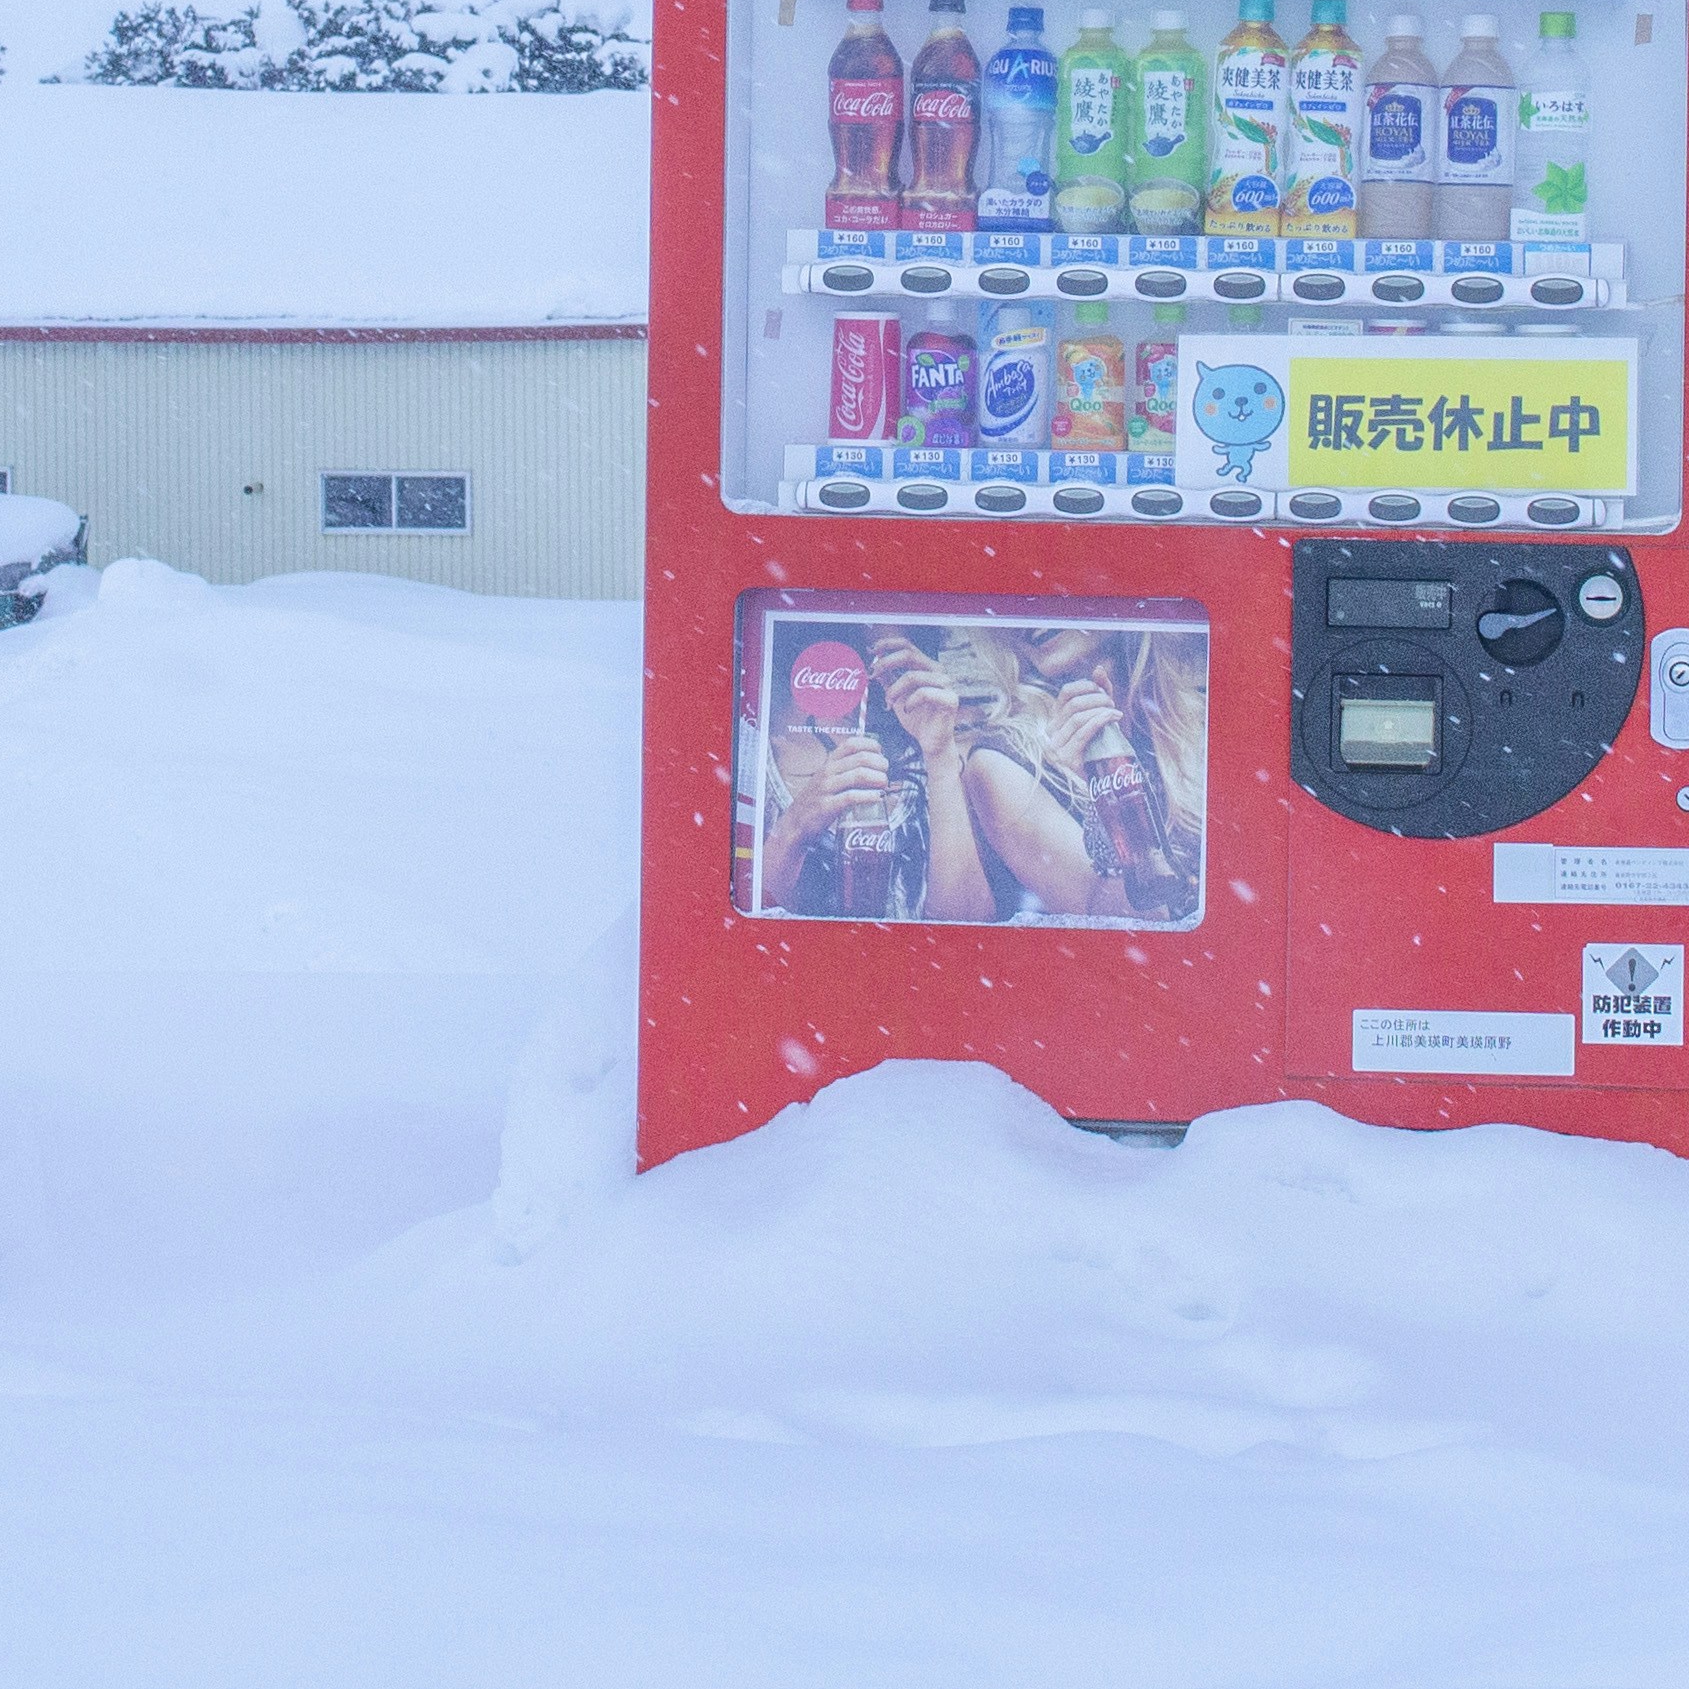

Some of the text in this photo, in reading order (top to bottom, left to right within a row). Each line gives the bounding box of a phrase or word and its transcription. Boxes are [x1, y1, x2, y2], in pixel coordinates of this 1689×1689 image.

[1222, 66, 1281, 91] 爽健美茶
[1295, 69, 1354, 92] 爽健美茶
[833, 92, 894, 117] Coca-Cola
[913, 93, 972, 118] Coca-Cola
[1073, 77, 1097, 124] 綾鷹
[1096, 73, 1110, 127] あやたか
[1146, 79, 1169, 126] 綾鷹
[1171, 75, 1183, 129] あやたか
[1535, 100, 1584, 112] いろはす
[1373, 112, 1418, 127] 紅茶花伝
[1450, 115, 1494, 130] 紅茶花伝
[1375, 127, 1413, 137] ROYAL
[1452, 130, 1490, 140] ROYAL
[1210, 220, 1271, 233] たっぷり飲める
[1286, 223, 1348, 233] たっぷり飲める
[838, 233, 864, 243] ¥160
[916, 235, 943, 245] ¥160
[993, 236, 1020, 247] ¥160
[1071, 238, 1098, 248] ¥160
[1148, 240, 1176, 250] ¥160
[1226, 241, 1254, 251] ¥160
[1305, 243, 1334, 253] ¥160
[1384, 244, 1412, 254] ¥160
[1463, 245, 1492, 255] ¥160
[835, 327, 865, 432] Coca-Cola
[911, 363, 964, 388] FANTA
[987, 359, 1034, 405] Ambasa
[1069, 398, 1102, 412] Qoo
[1307, 393, 1601, 453] 販売休止中
[836, 451, 863, 461] ¥130
[913, 452, 940, 462] ¥130
[991, 453, 1018, 463] ¥130
[1069, 455, 1095, 465] ¥130
[1147, 457, 1174, 467] ¥130
[793, 665, 862, 691] Coca-Cola
[787, 725, 813, 733] TASTE
[814, 725, 830, 733] THE
[1089, 763, 1144, 802] Coca-Cola
[1592, 994, 1672, 1015] 防犯装置
[1360, 1018, 1431, 1031] ここの住所は
[1602, 1018, 1662, 1038] 作動中
[1372, 1034, 1512, 1050] 上川郡美瑛町美瑛原野
